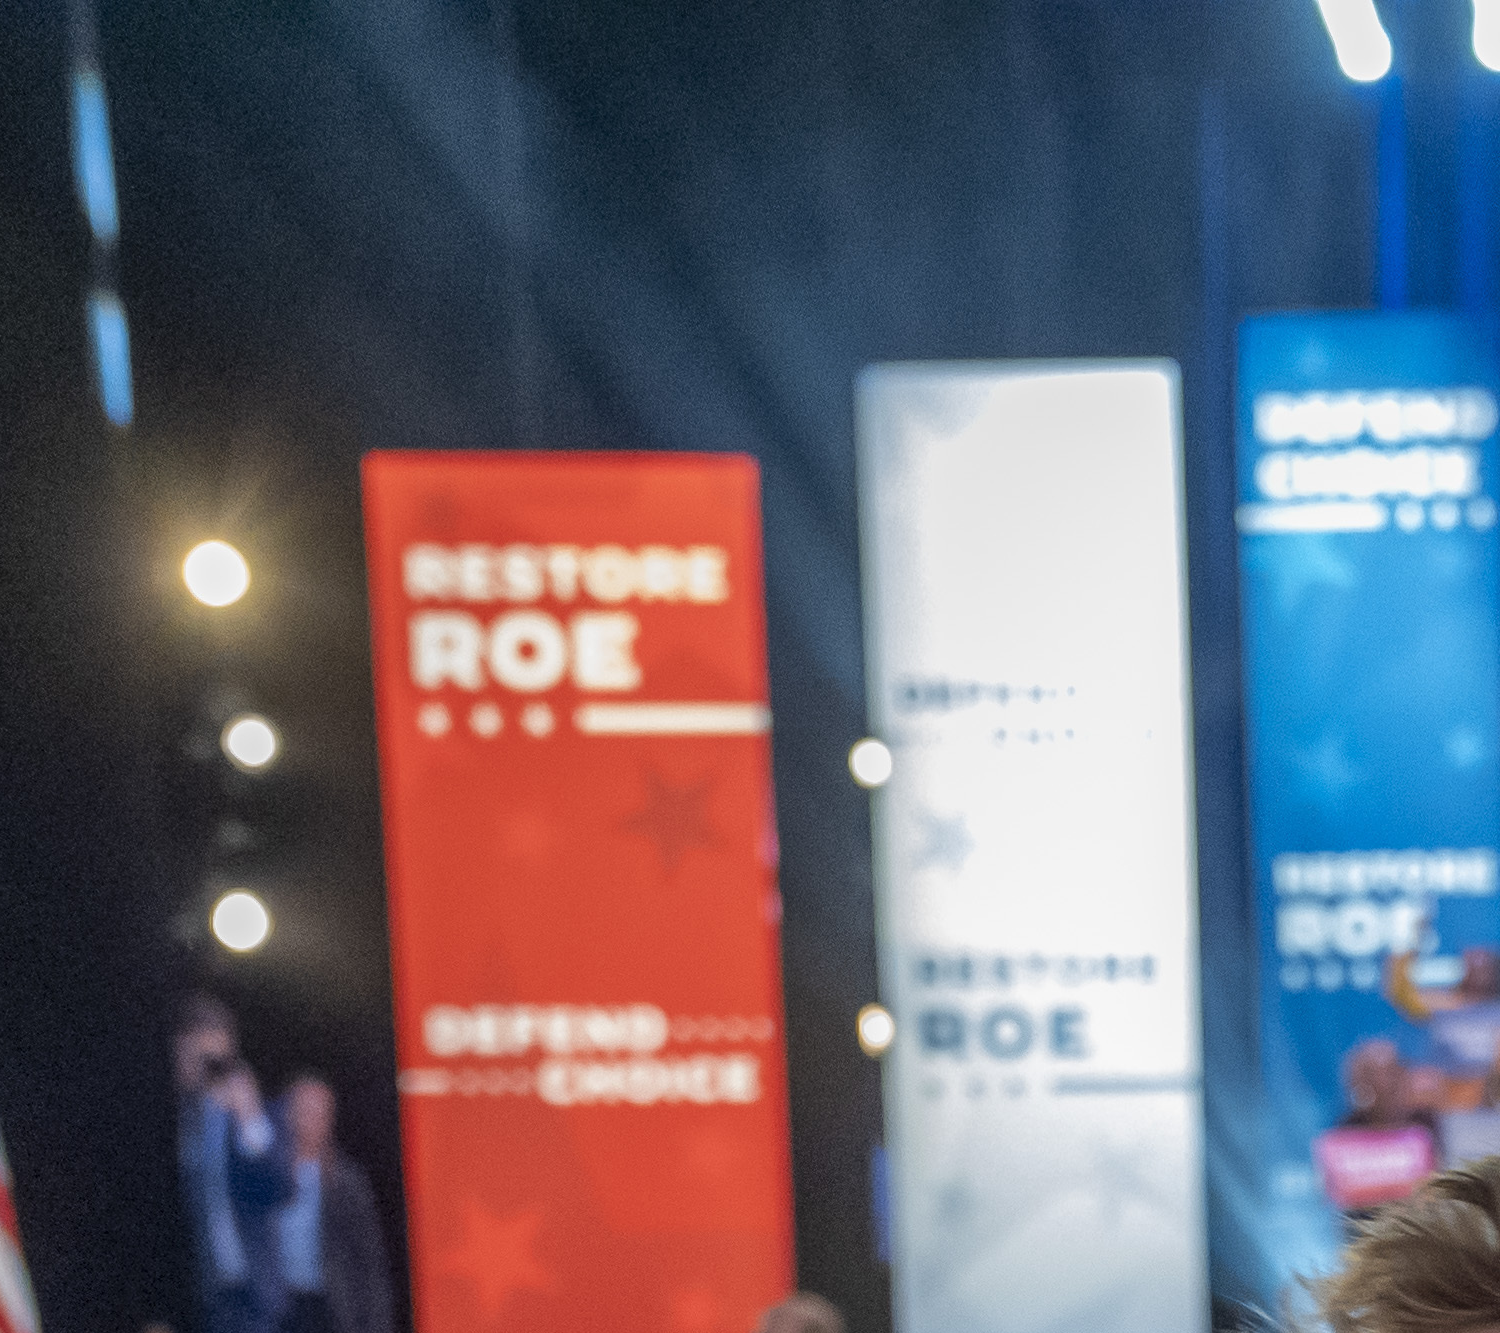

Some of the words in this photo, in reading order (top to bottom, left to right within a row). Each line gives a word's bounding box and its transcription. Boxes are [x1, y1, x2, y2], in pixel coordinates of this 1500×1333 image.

[402, 540, 730, 605] RESTORE
[408, 610, 642, 692] ROE
[422, 1003, 667, 1057] DEFEND
[917, 1003, 1092, 1061] ROE
[537, 1051, 755, 1106] CHOICE
